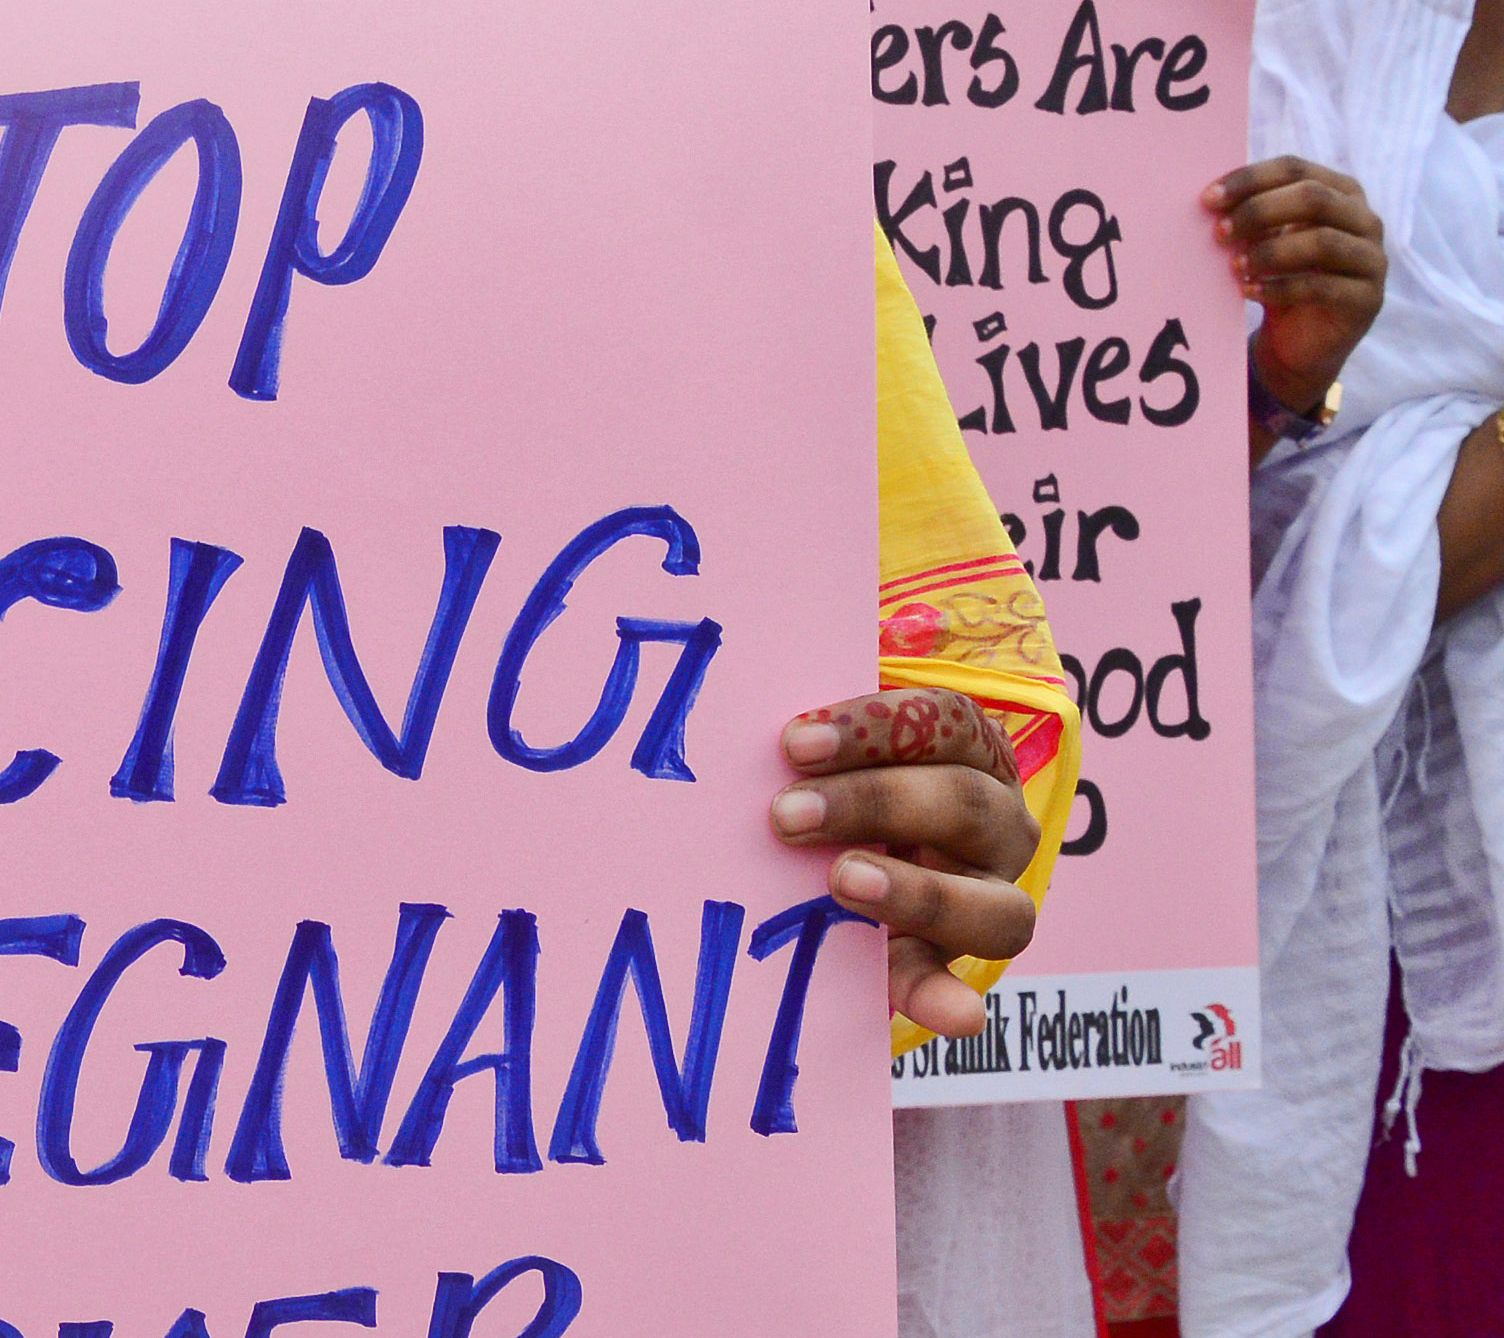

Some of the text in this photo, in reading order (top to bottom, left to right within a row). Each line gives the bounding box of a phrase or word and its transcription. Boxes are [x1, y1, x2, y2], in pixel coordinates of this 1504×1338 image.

[869, 12, 1020, 109] ers
[873, 156, 1123, 310] king
[1017, 985, 1162, 1072] Federation
